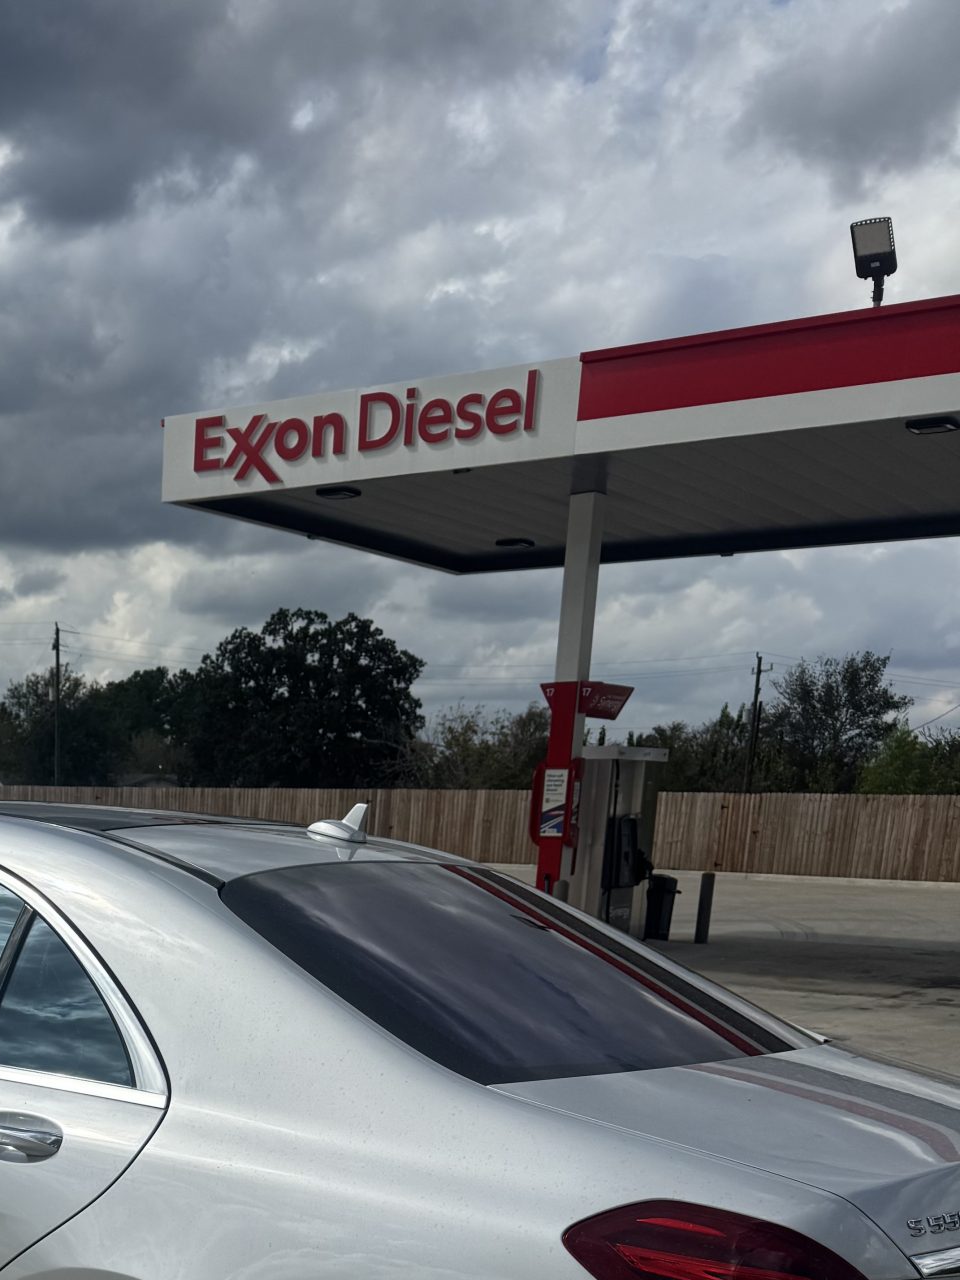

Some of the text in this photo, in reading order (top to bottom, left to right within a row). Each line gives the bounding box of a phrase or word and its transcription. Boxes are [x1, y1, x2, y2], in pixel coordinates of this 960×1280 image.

[193, 369, 539, 483] Exxon Diesel
[545, 687, 555, 697] 17
[582, 687, 592, 697] 17
